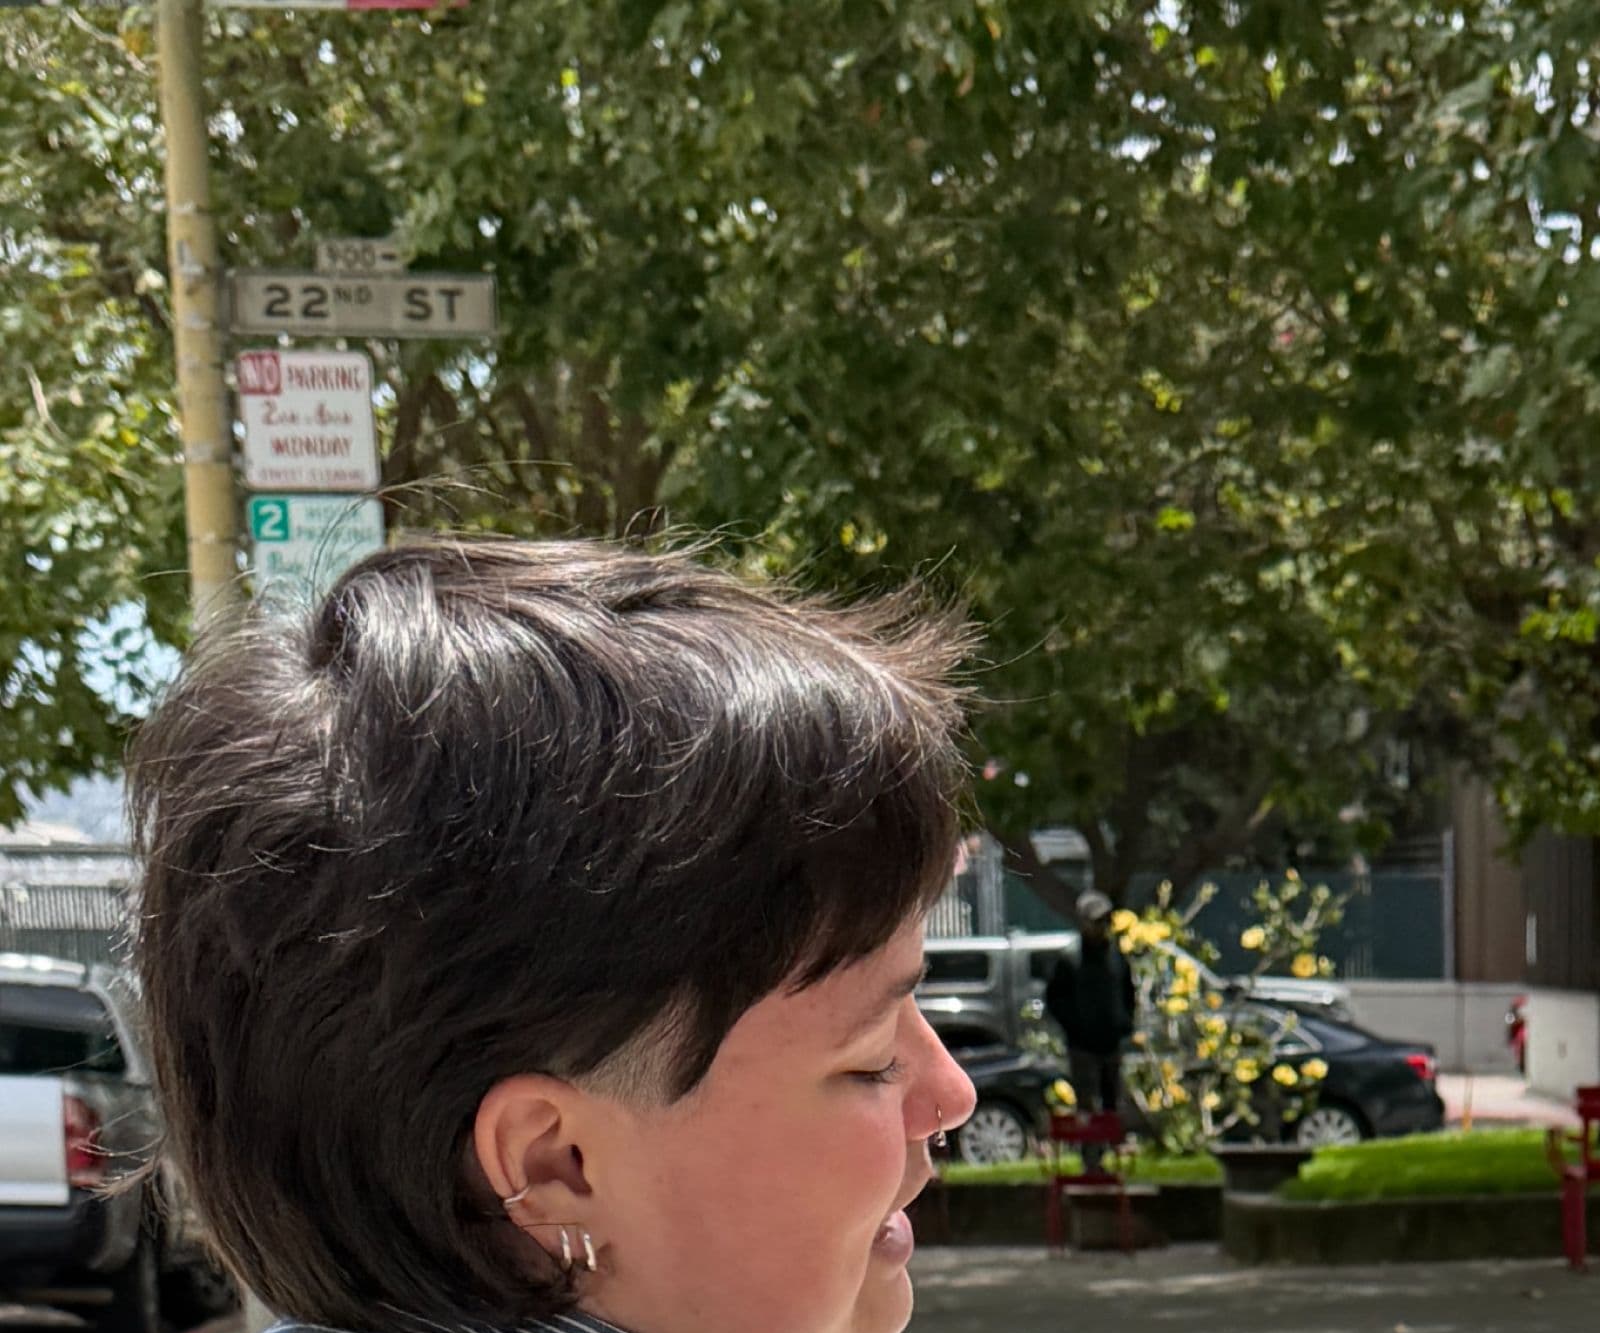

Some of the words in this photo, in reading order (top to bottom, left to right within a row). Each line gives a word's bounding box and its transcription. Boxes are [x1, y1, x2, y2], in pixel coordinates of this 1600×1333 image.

[263, 284, 372, 319] 22ND
[404, 288, 466, 322] ST
[240, 357, 279, 391] NO
[287, 365, 365, 391] PARKING
[271, 435, 353, 457] MONDAY
[258, 504, 284, 537] 2
